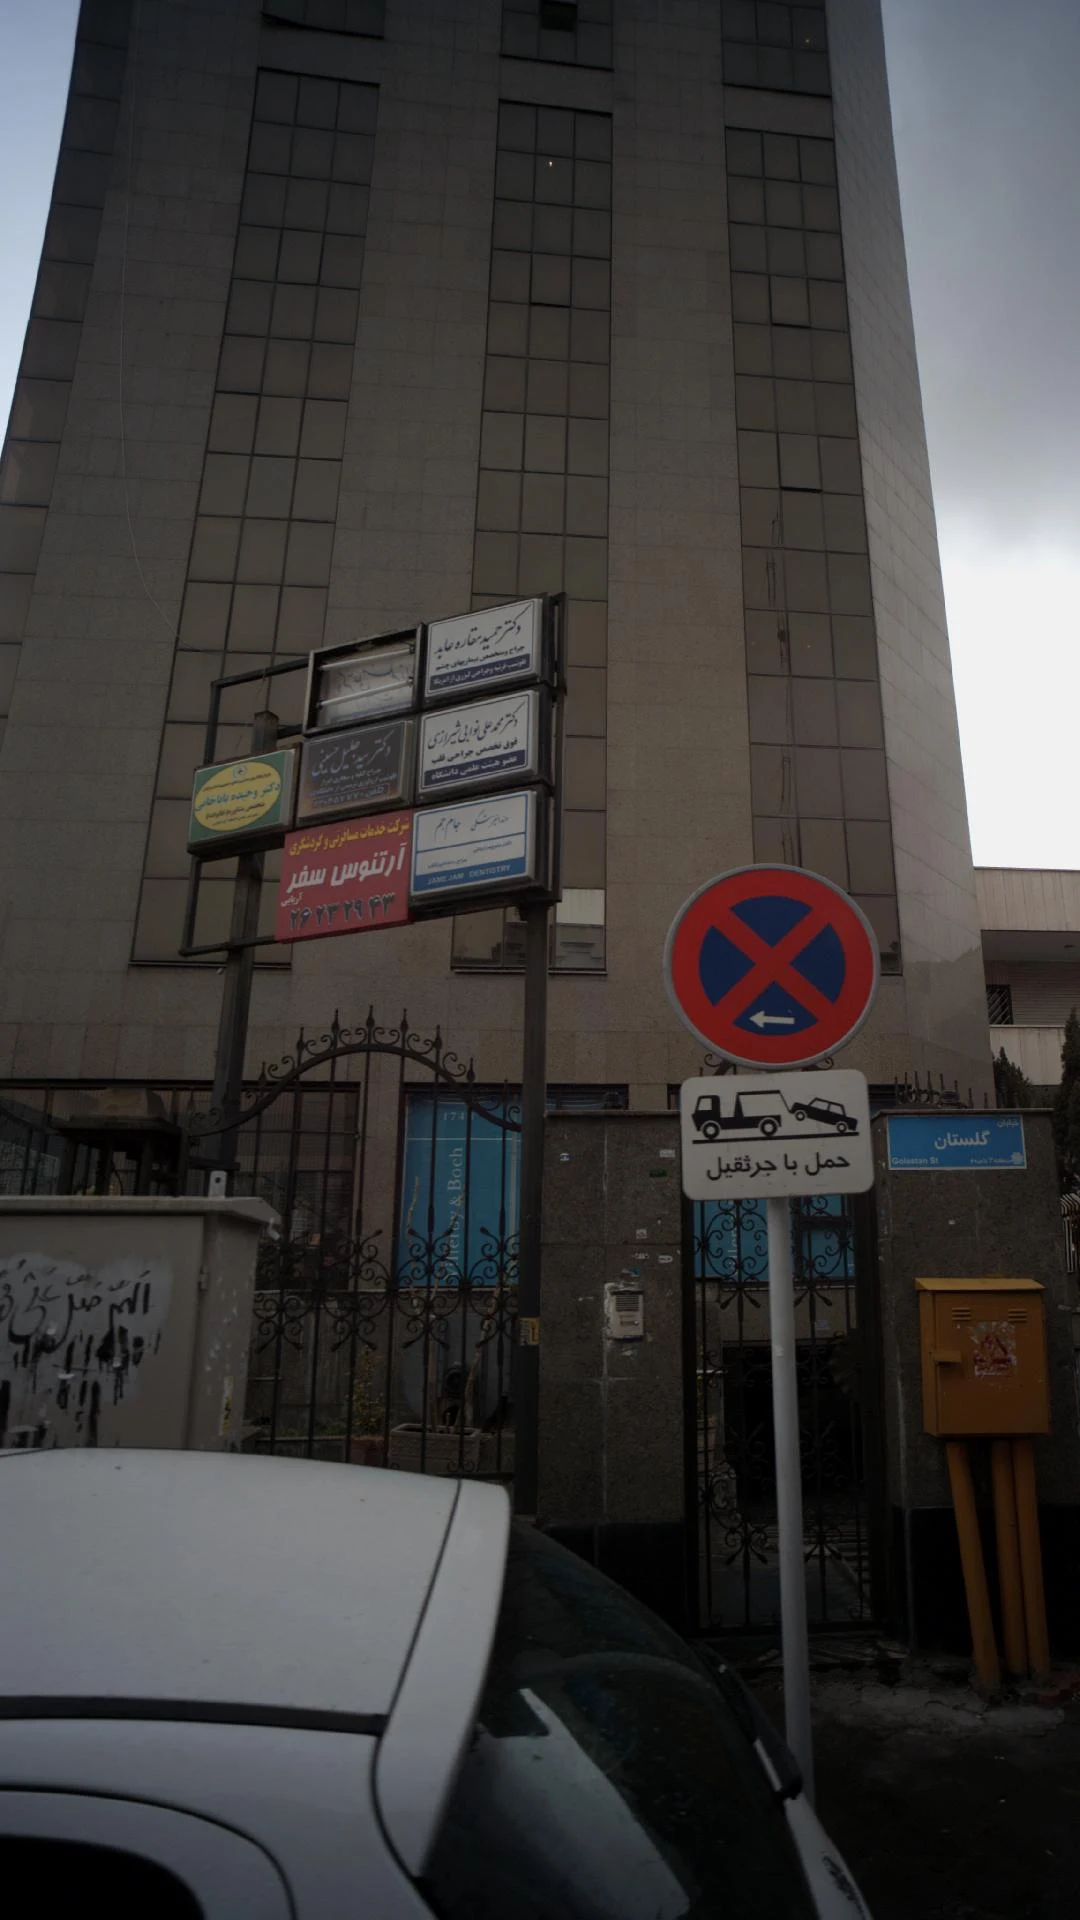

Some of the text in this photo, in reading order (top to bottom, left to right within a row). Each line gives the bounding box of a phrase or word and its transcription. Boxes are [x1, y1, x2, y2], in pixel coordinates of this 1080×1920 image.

[495, 603, 531, 646] دکتر
[499, 699, 526, 736] دکتر
[366, 728, 396, 767] دکتر
[431, 737, 518, 763] فوق تخصص جراحی قلب
[431, 768, 459, 780] دانشگاه
[359, 822, 387, 841] خدمات
[386, 816, 411, 837] شرکت
[288, 833, 325, 857] گردشگری
[328, 827, 361, 850] مسافرتی
[285, 841, 409, 895] آرتنوس سفر
[469, 864, 513, 879] DENTISTRY
[996, 1118, 1020, 1129] خیابان
[934, 1129, 991, 1150] گلستان
[447, 1147, 463, 1191] Boch
[706, 1151, 851, 1181] حمل با جرثقیل
[448, 1194, 464, 1208] &
